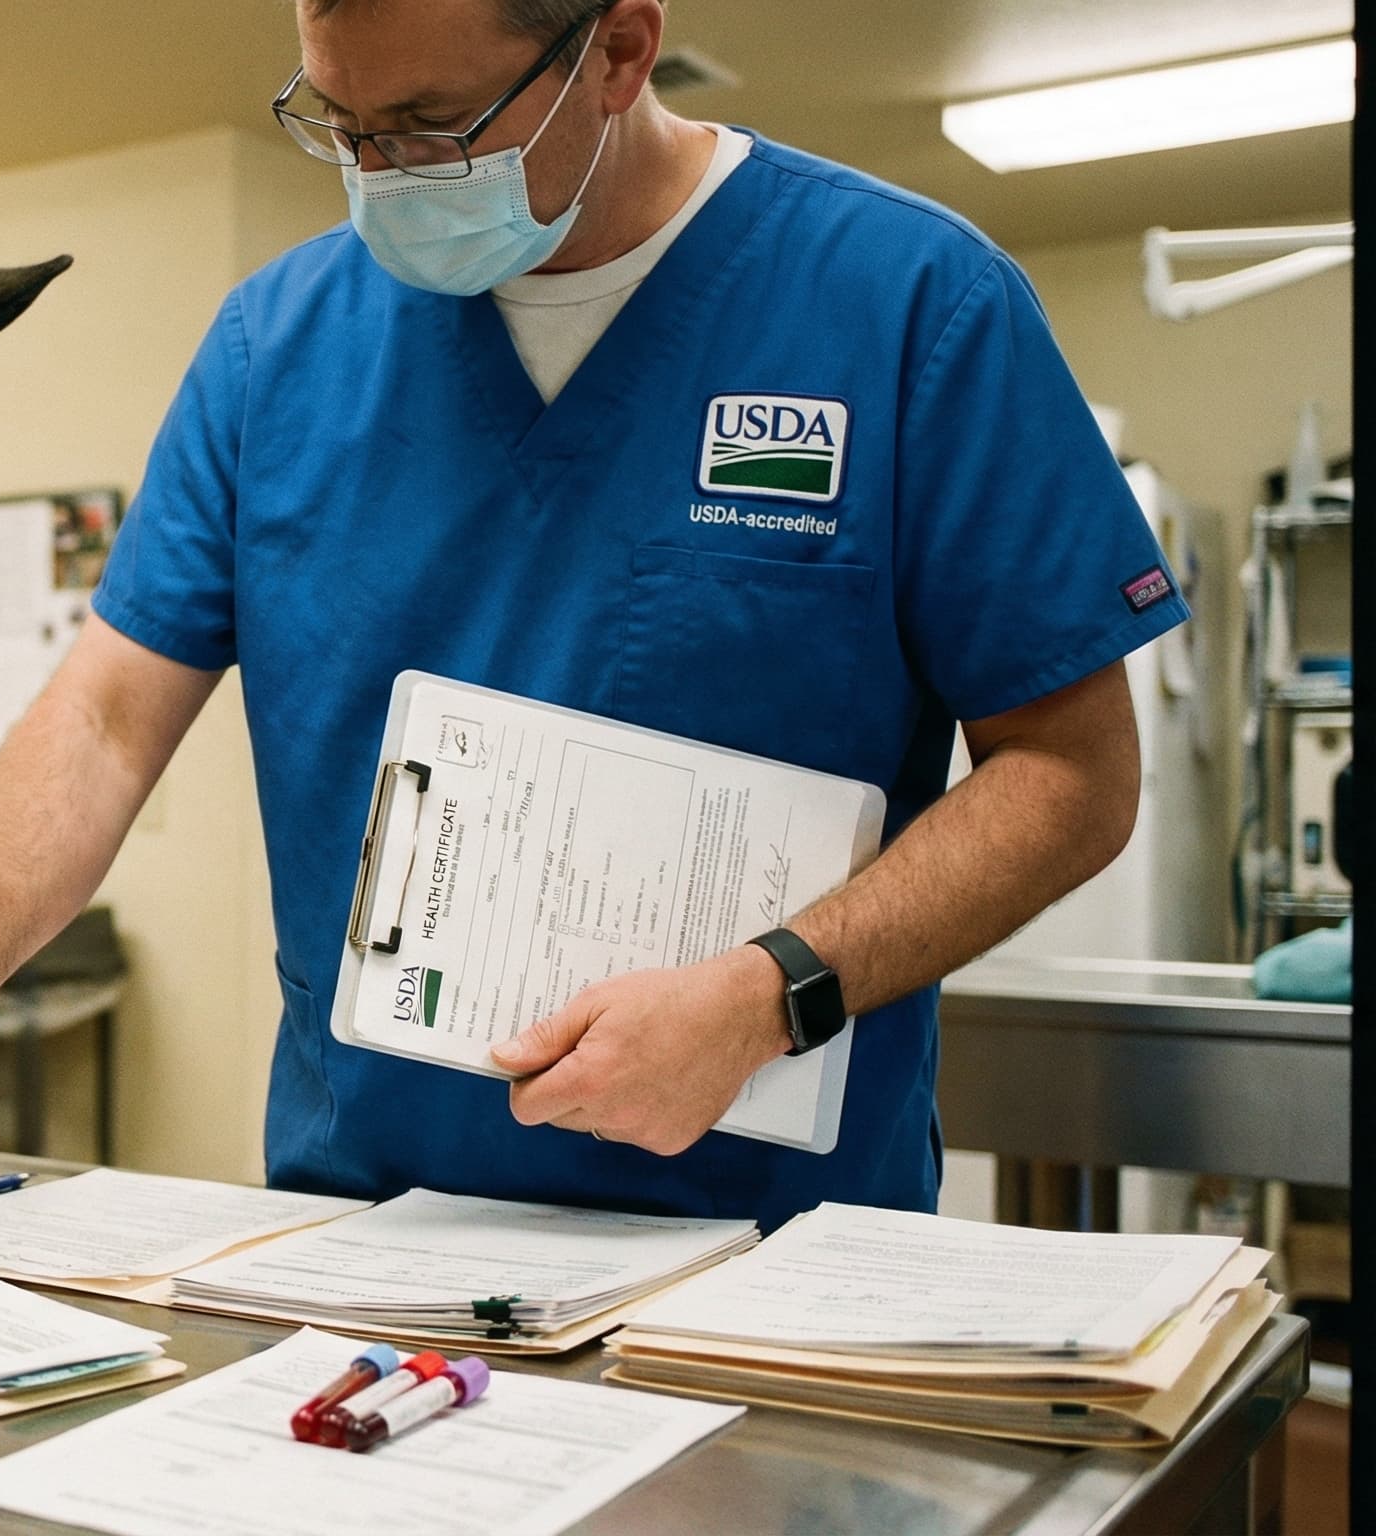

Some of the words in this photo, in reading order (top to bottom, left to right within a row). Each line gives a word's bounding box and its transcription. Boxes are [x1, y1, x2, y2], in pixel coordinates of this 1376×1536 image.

[715, 404, 835, 447] USDA
[689, 503, 838, 536] USDA-accredited
[422, 886, 441, 940] HEALTH
[432, 797, 458, 883] CERTIFICATE
[393, 965, 420, 1024] USDA
